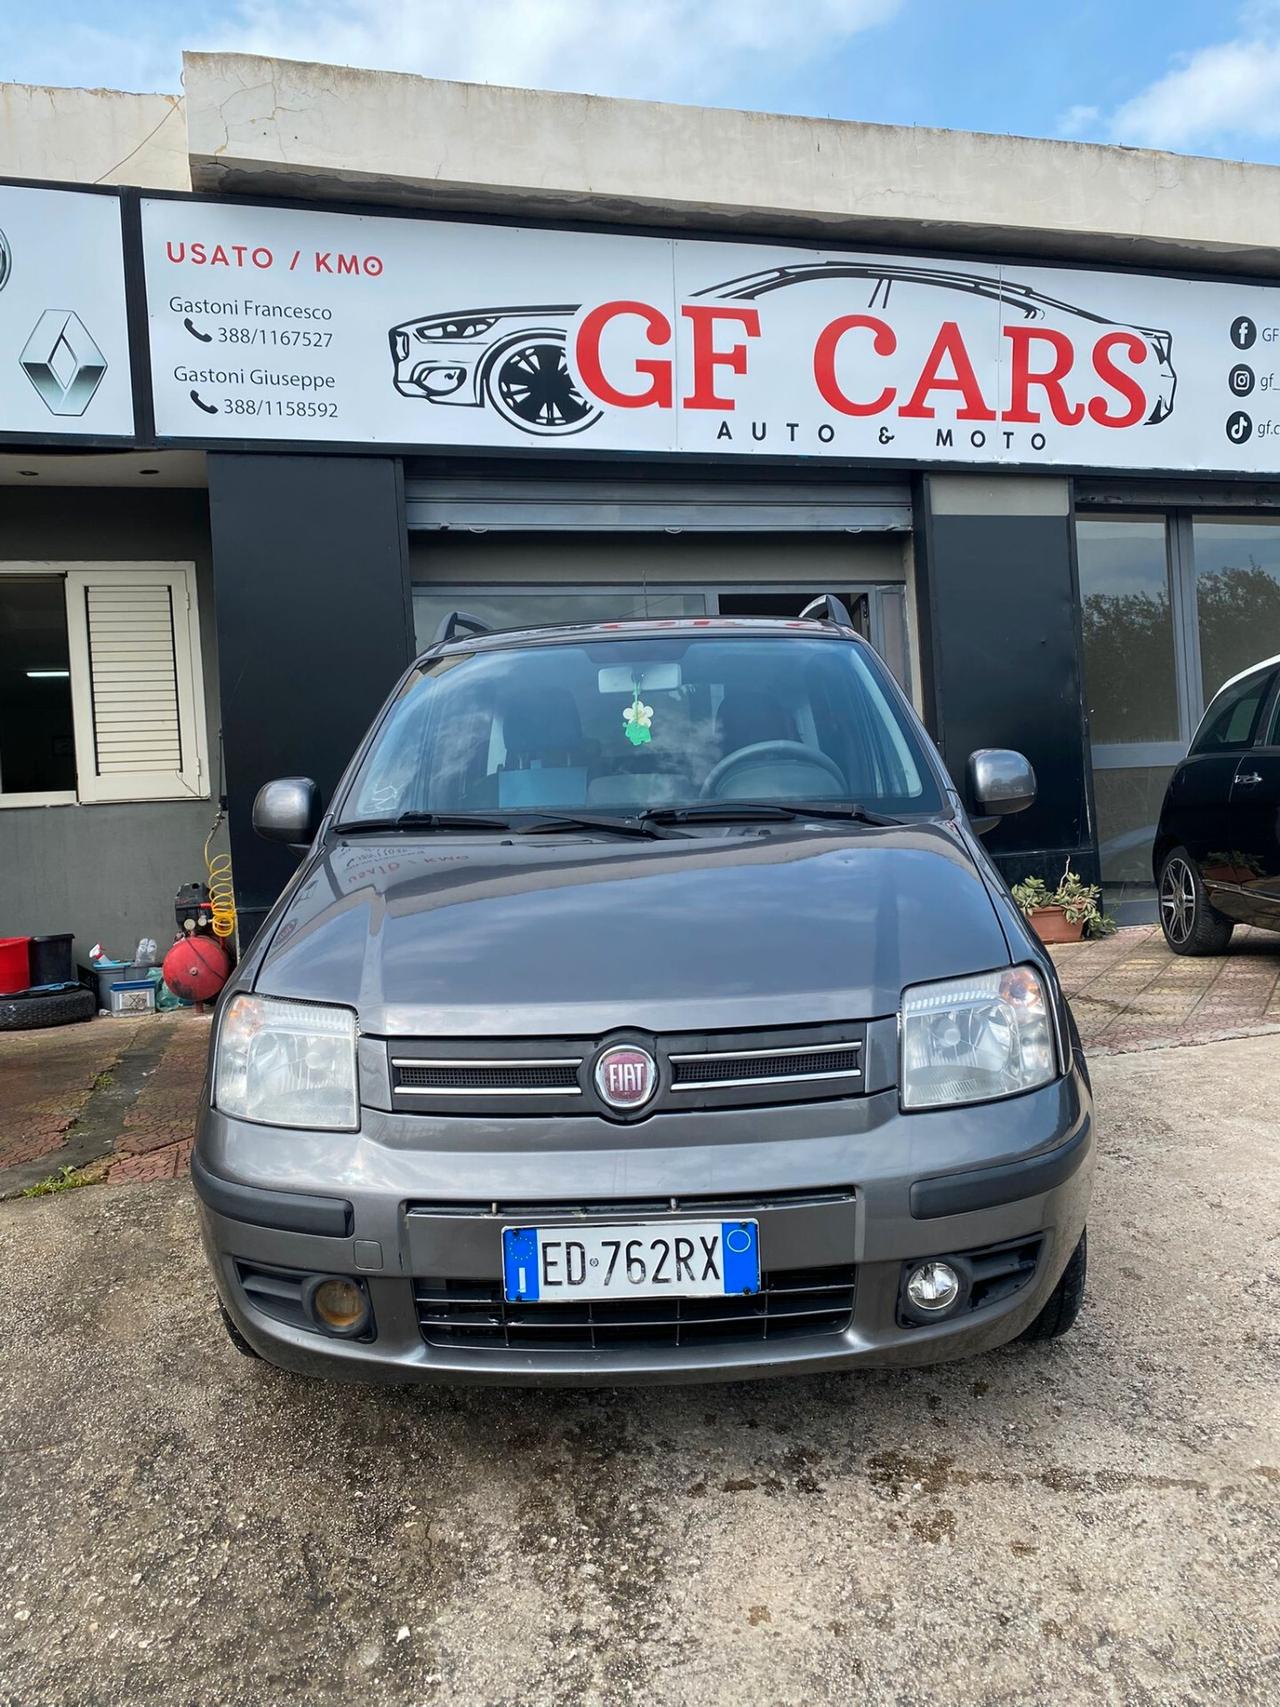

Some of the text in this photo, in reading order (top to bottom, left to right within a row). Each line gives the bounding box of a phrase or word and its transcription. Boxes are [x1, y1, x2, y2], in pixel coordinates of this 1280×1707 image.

[166, 241, 274, 269] USATO
[169, 296, 333, 321] Gastoni Francesco
[217, 327, 333, 348] 388/1167527
[173, 365, 336, 391] Gastoni Giuseppe
[575, 300, 1148, 429] GF CARS
[223, 399, 339, 418] 388/1158592
[716, 420, 1047, 451] AUTO & MOTO
[609, 1062, 645, 1092] FIAT
